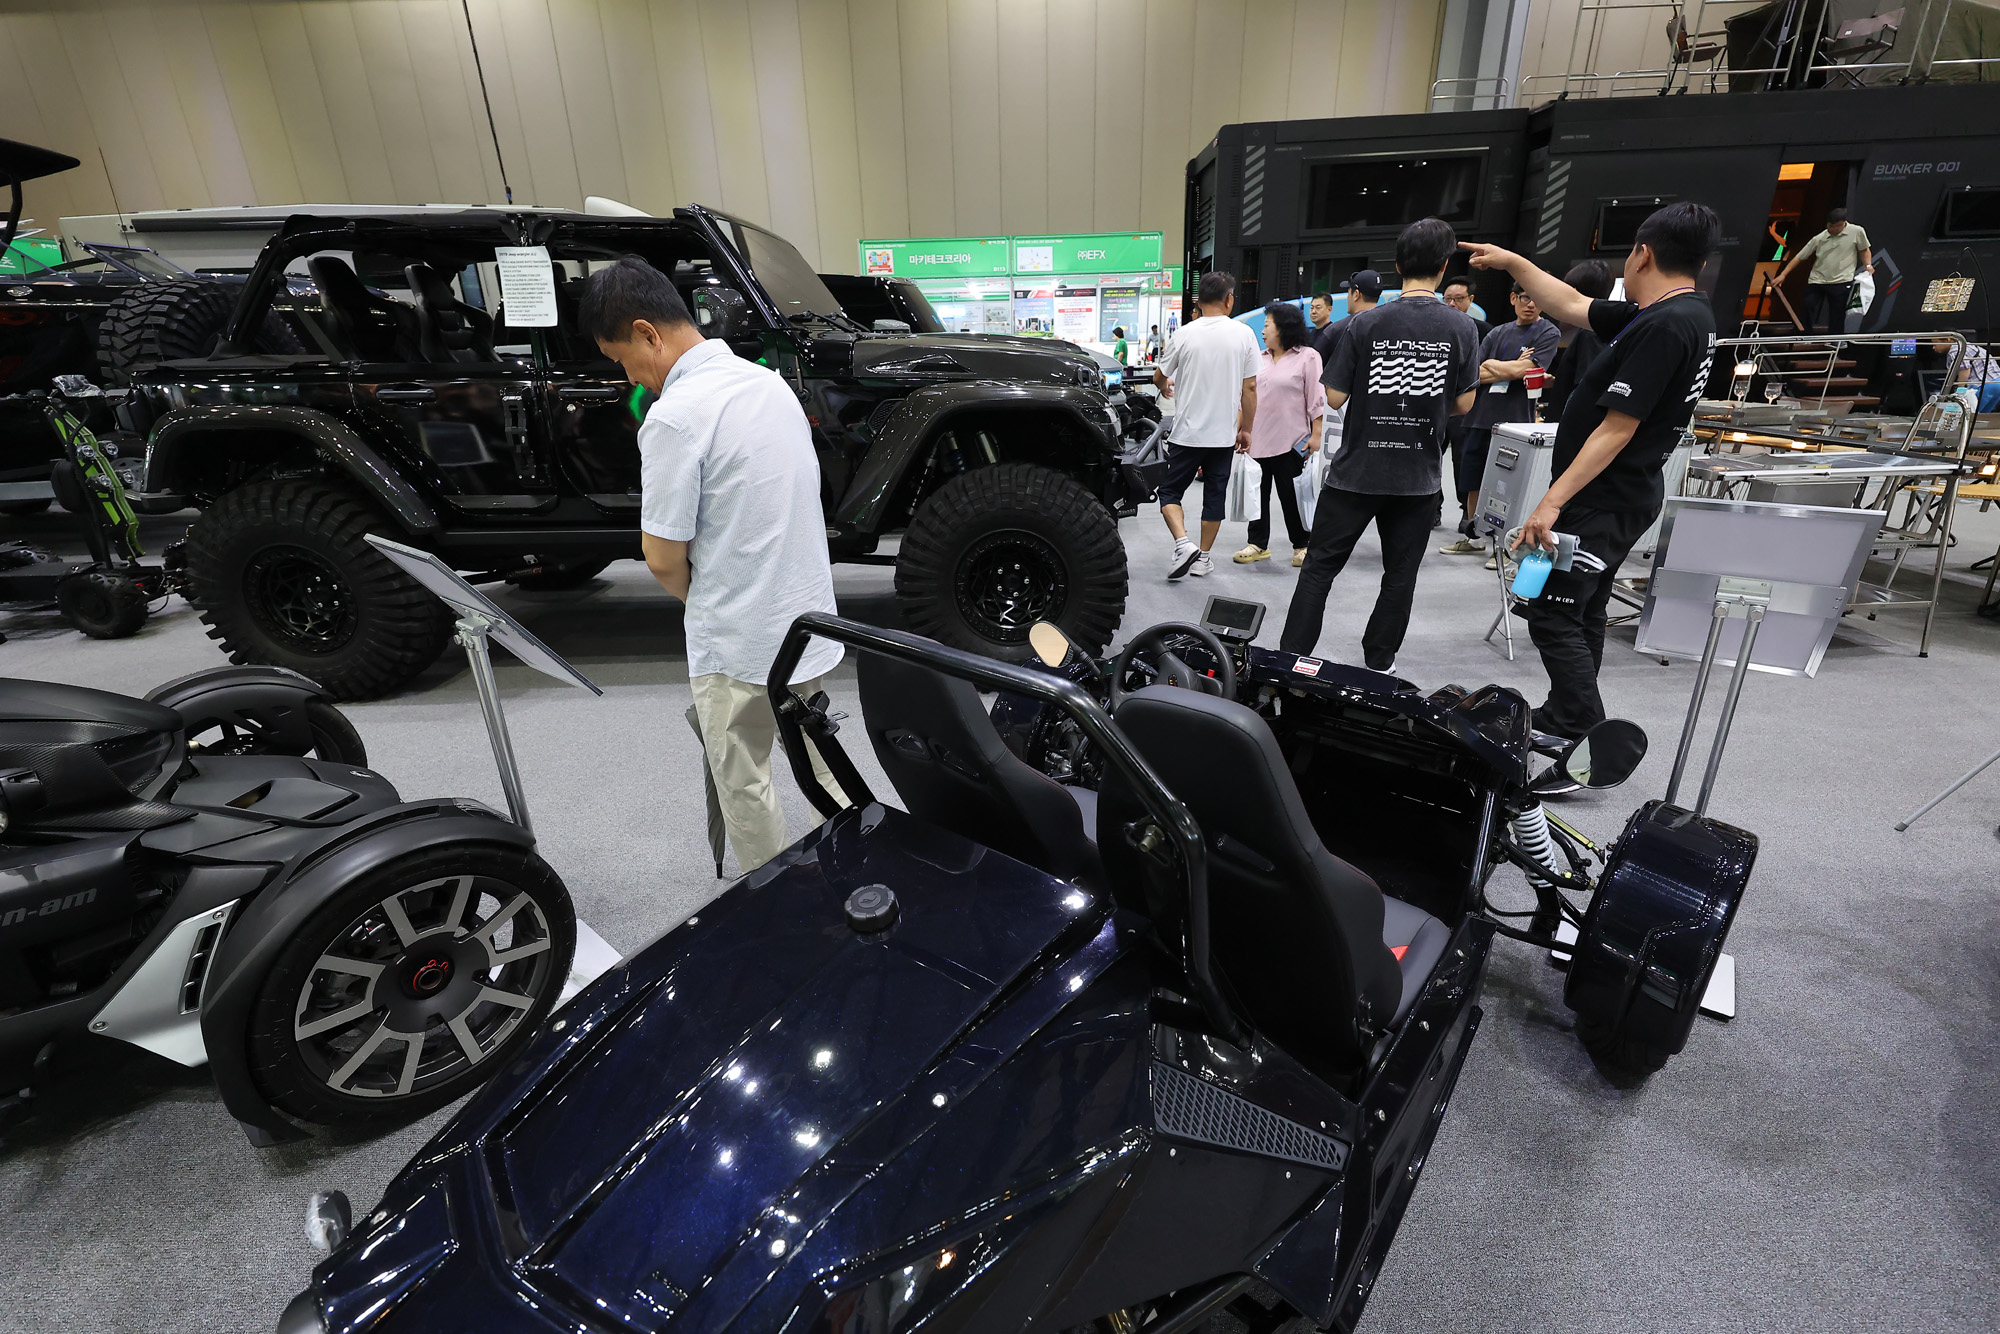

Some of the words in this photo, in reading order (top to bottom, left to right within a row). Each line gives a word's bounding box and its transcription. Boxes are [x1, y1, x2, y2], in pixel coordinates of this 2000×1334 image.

[1874, 163, 1933, 175] BUNKER
[1936, 161, 1961, 173] 001
[908, 253, 972, 265] 마키테크코리아
[1372, 340, 1451, 352] BUNKER
[0, 888, 97, 927] n-am
